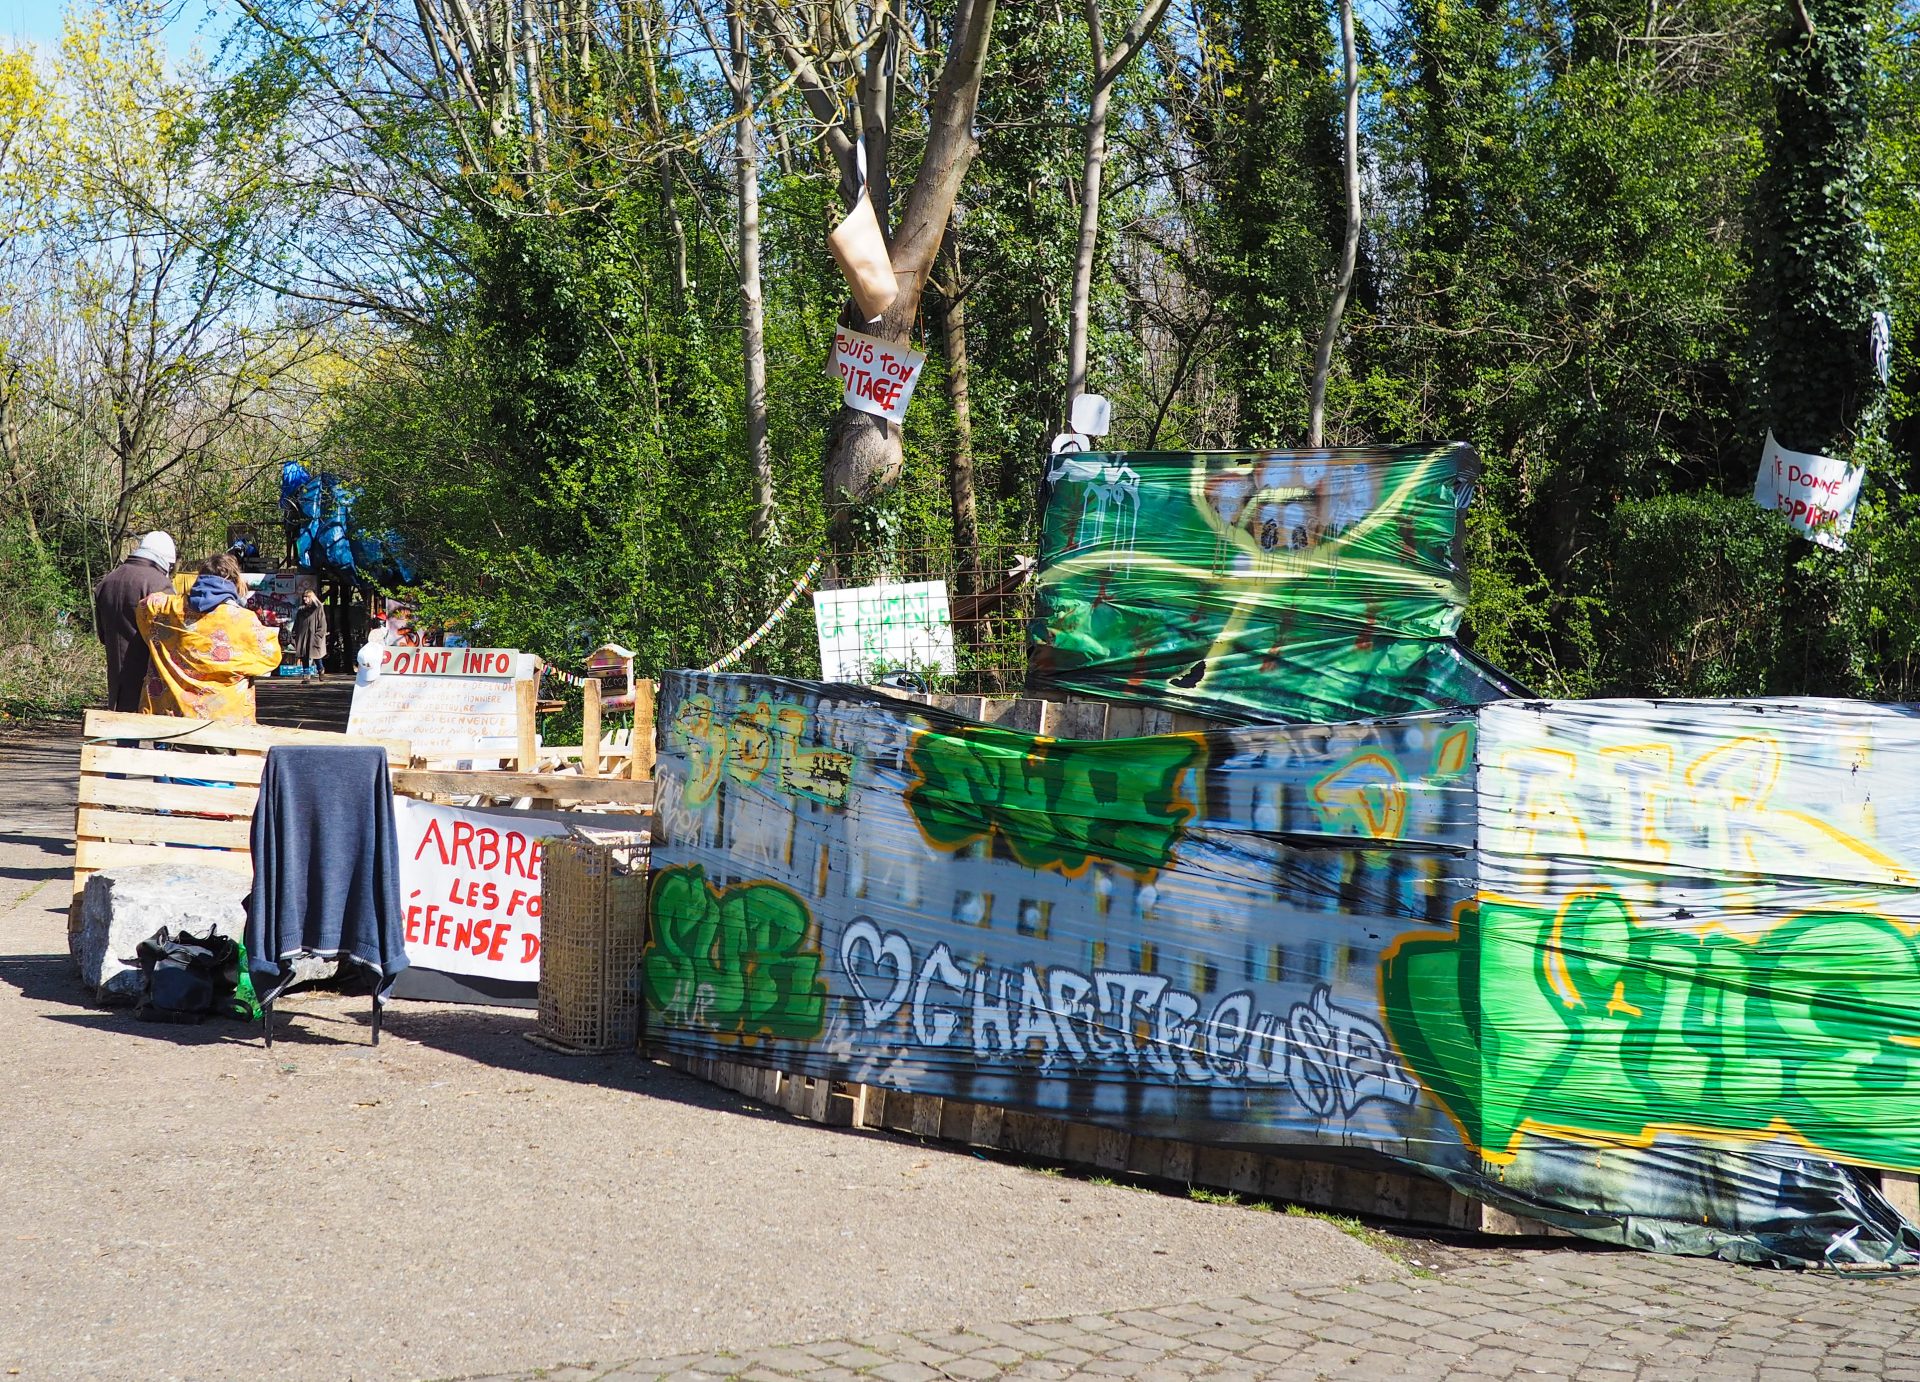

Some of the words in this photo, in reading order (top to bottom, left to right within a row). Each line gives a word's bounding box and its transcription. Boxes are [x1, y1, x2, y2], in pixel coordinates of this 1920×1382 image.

[837, 334, 874, 364] SUIS
[879, 352, 915, 383] TON
[1788, 465, 1842, 496] DONNE
[381, 647, 452, 675] POINT
[462, 648, 510, 674] INFO
[414, 818, 542, 880] ARBRE
[449, 878, 499, 910] LES
[401, 889, 511, 961] ÉFENSE
[912, 941, 1420, 1118] CHARTREUSE
